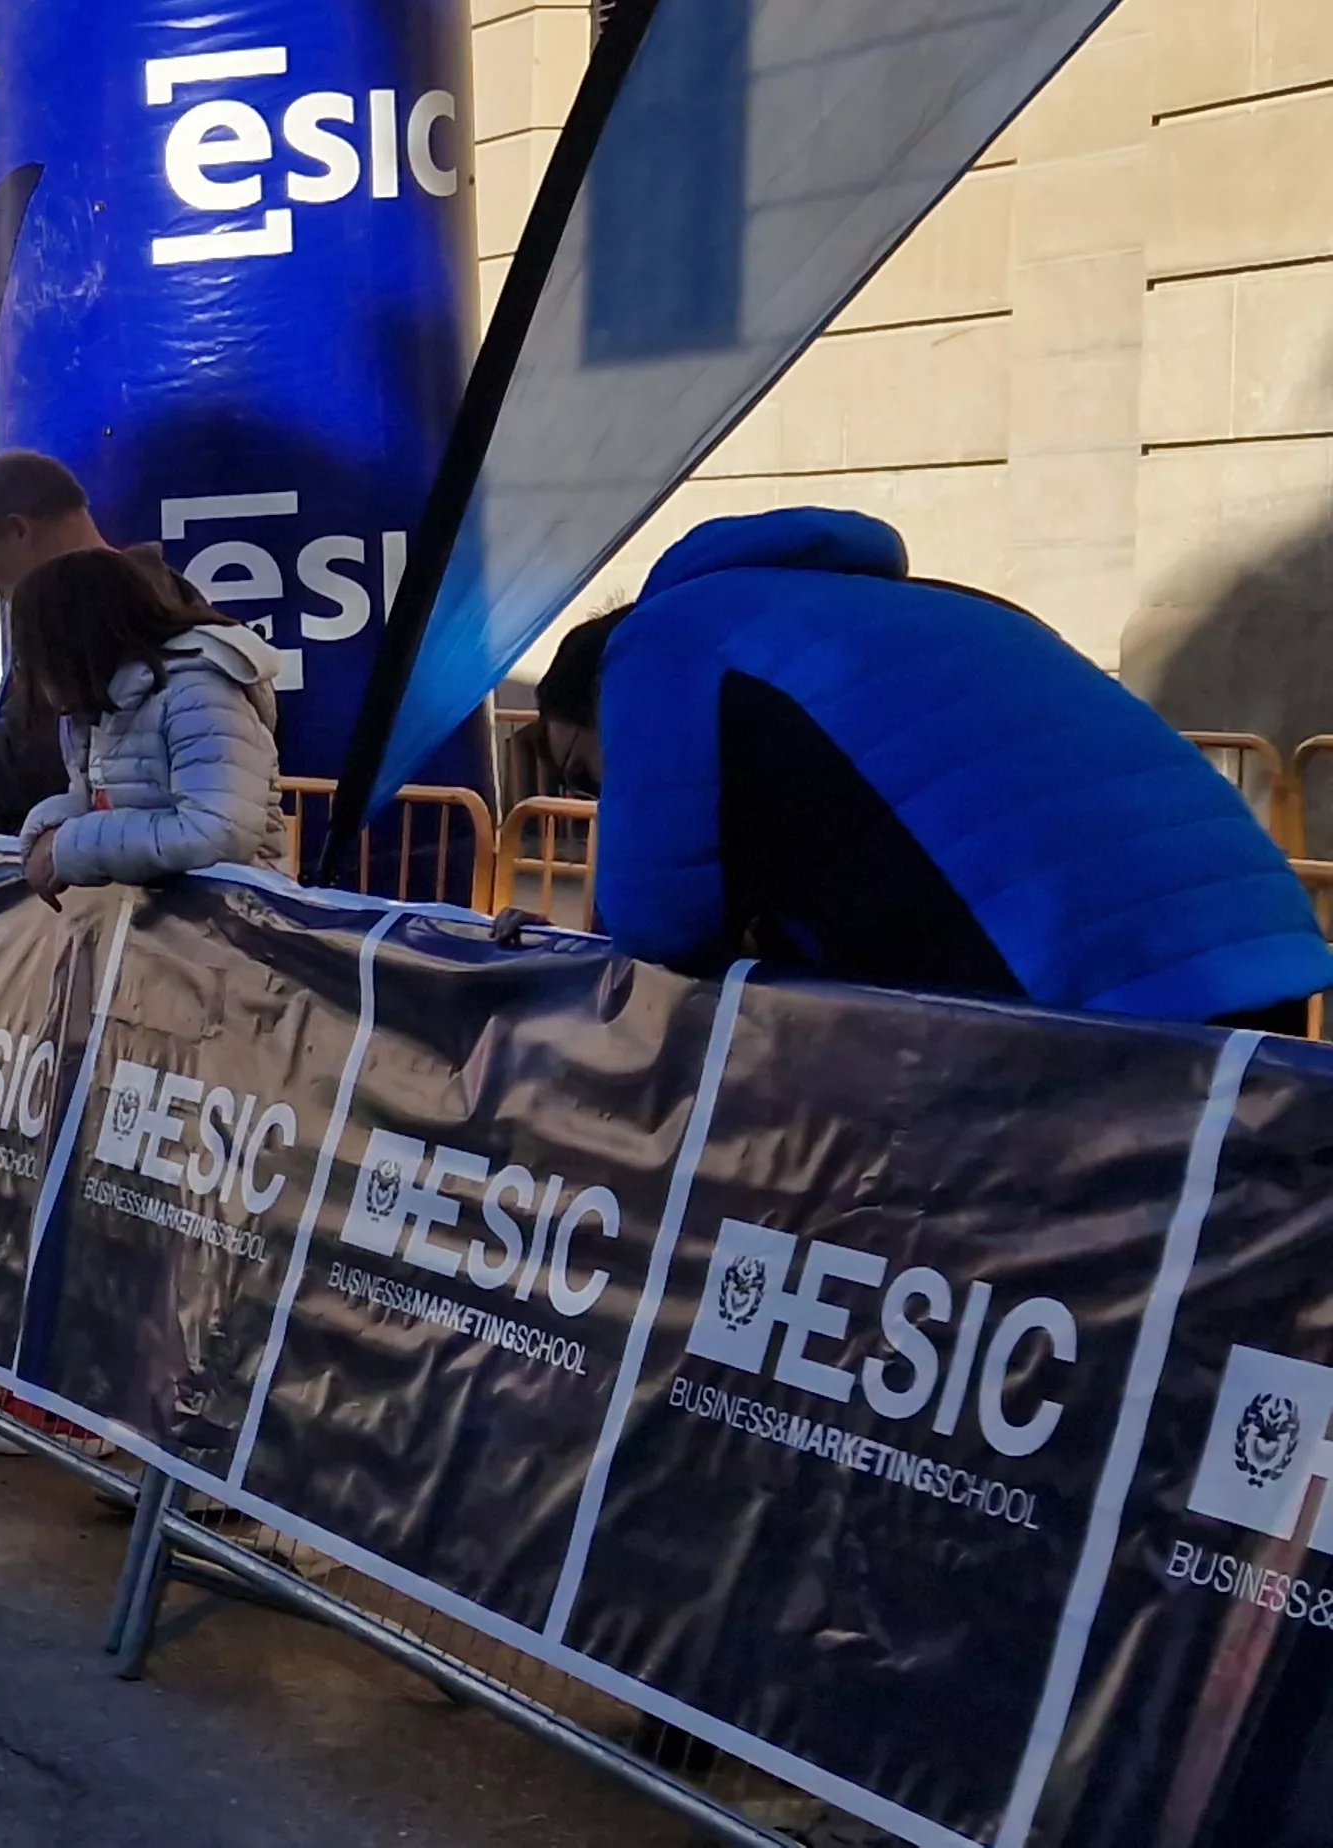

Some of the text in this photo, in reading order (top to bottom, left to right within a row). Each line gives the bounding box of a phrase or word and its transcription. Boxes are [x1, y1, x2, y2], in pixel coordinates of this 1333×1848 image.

[139, 1072, 298, 1215] ESIC
[401, 1143, 621, 1318] ESIC
[770, 1237, 1079, 1458] ESIC
[1166, 1539, 1333, 1631] BUSINESS&
